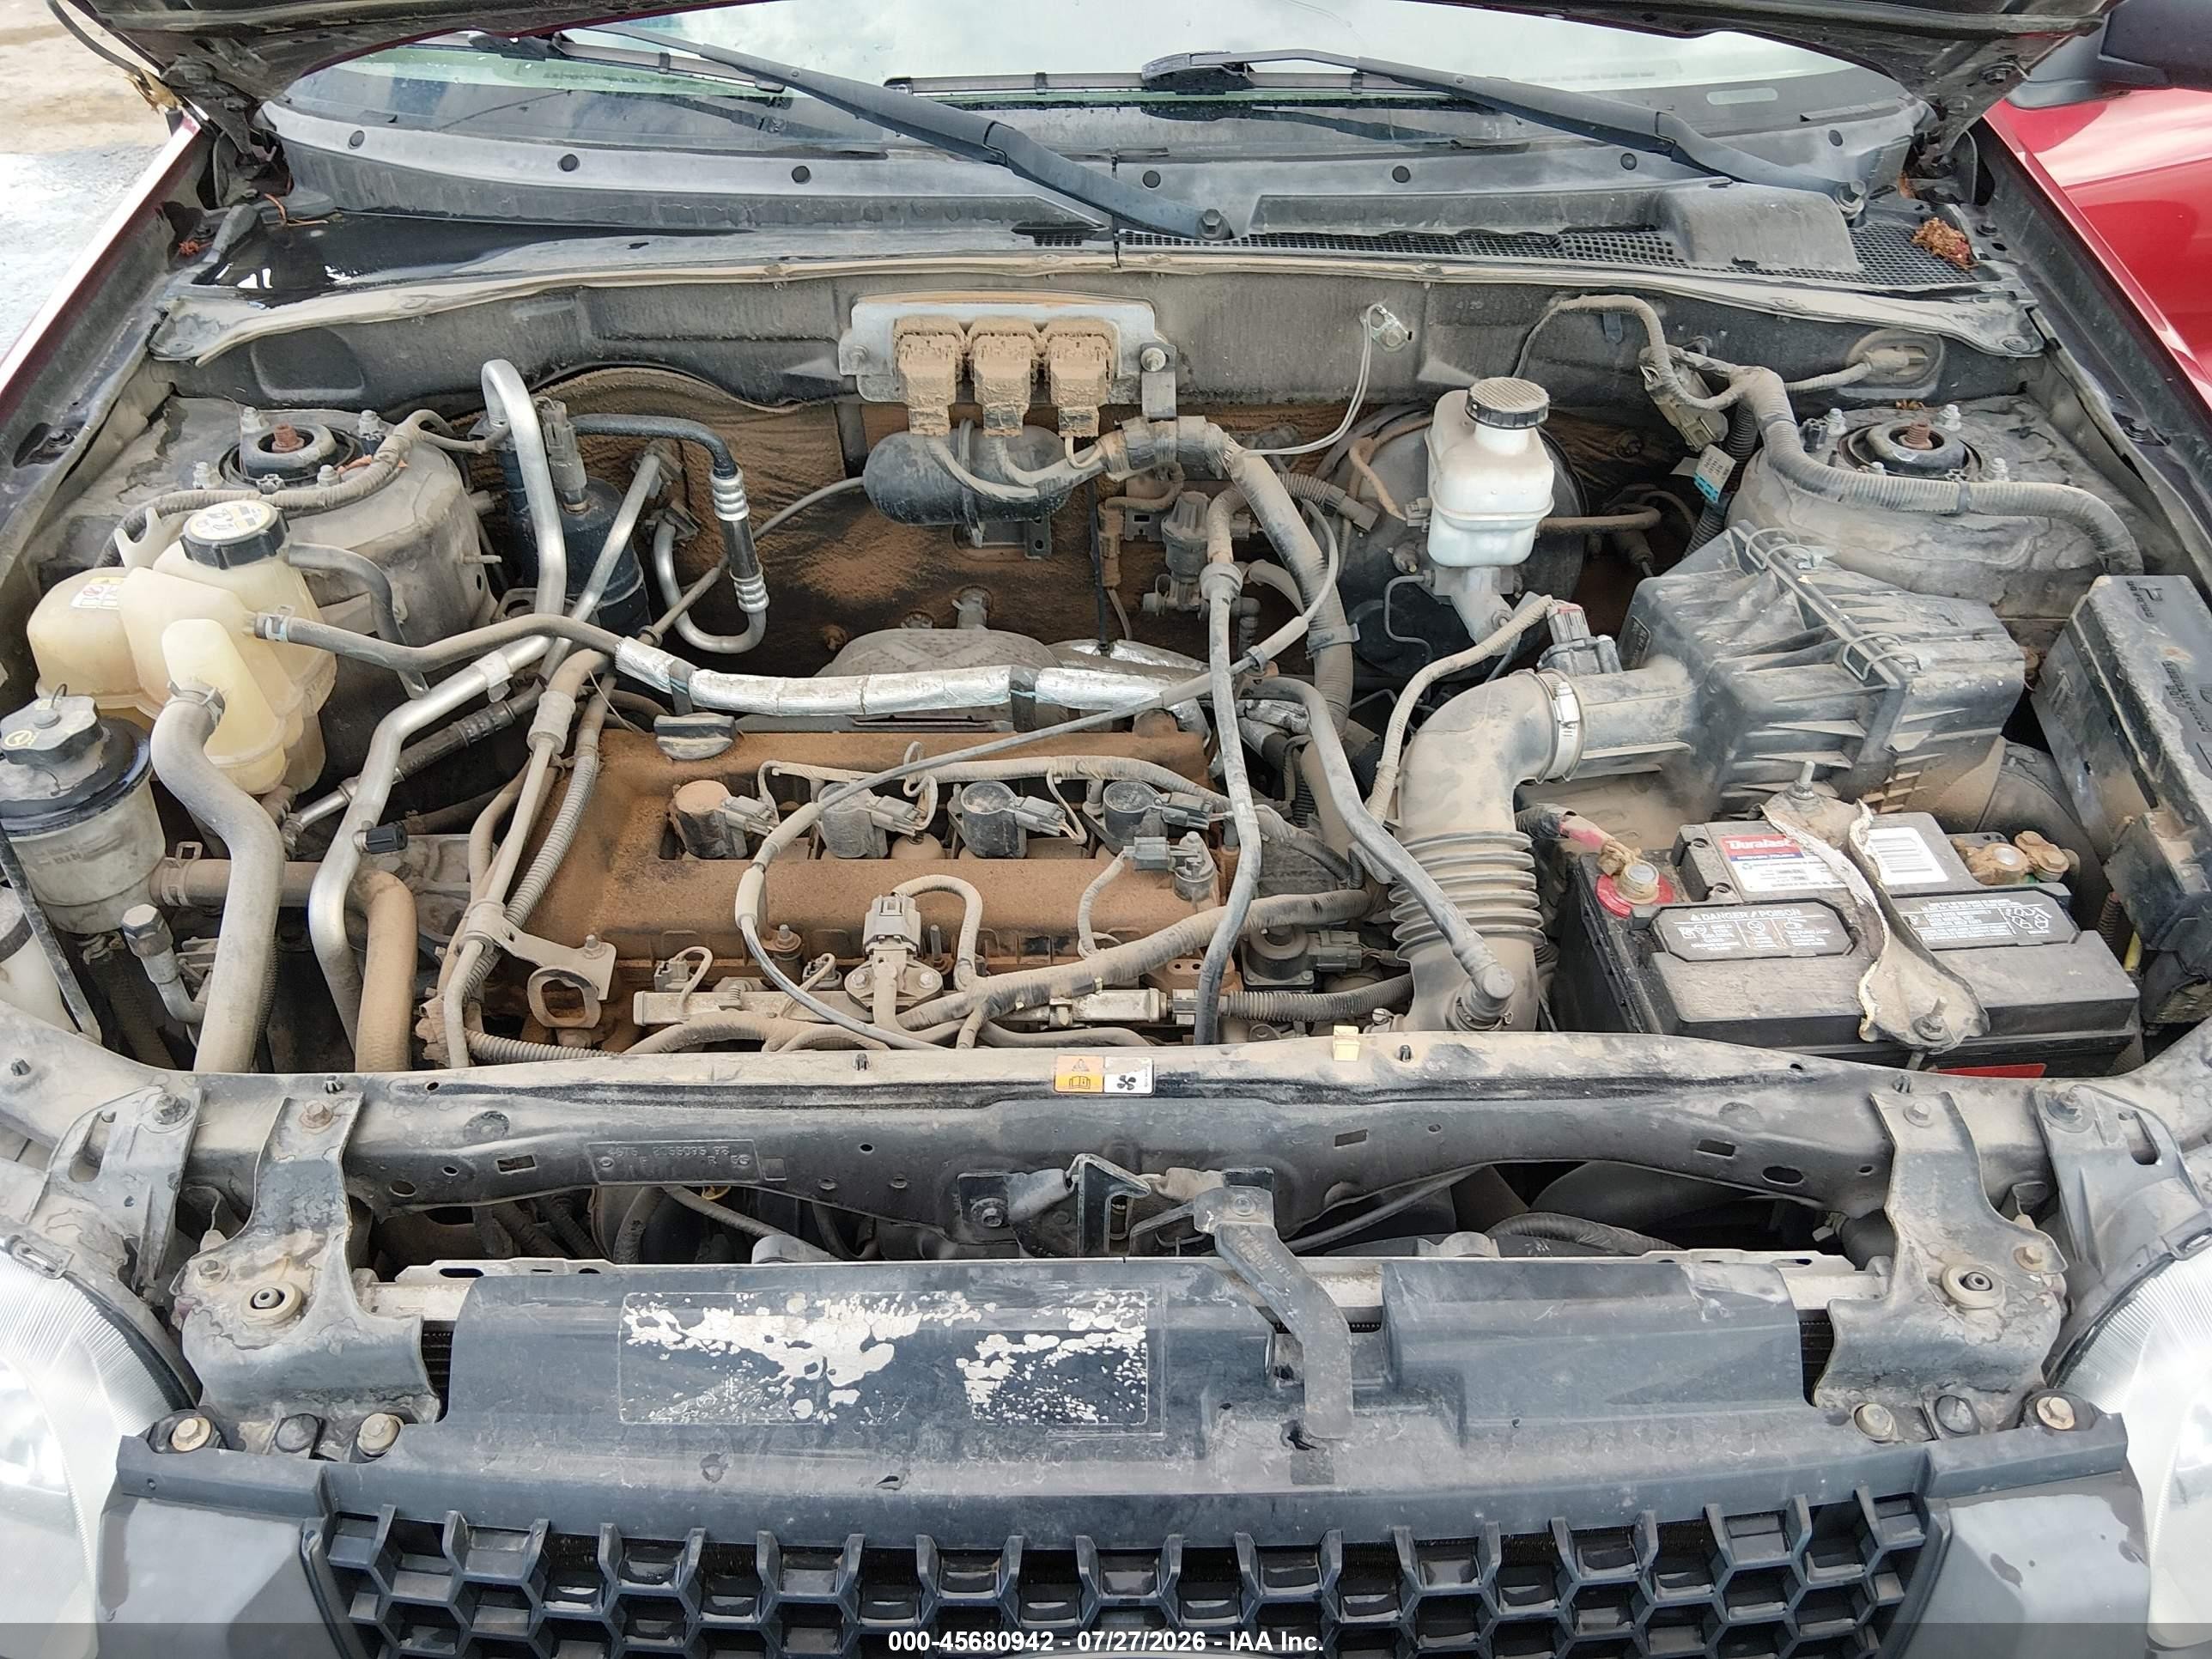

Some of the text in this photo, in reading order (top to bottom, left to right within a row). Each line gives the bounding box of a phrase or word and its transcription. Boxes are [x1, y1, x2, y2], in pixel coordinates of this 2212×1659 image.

[1724, 838, 1795, 850] Duralast
[1701, 911, 1747, 921] DANGER
[1759, 908, 1802, 918] POISON
